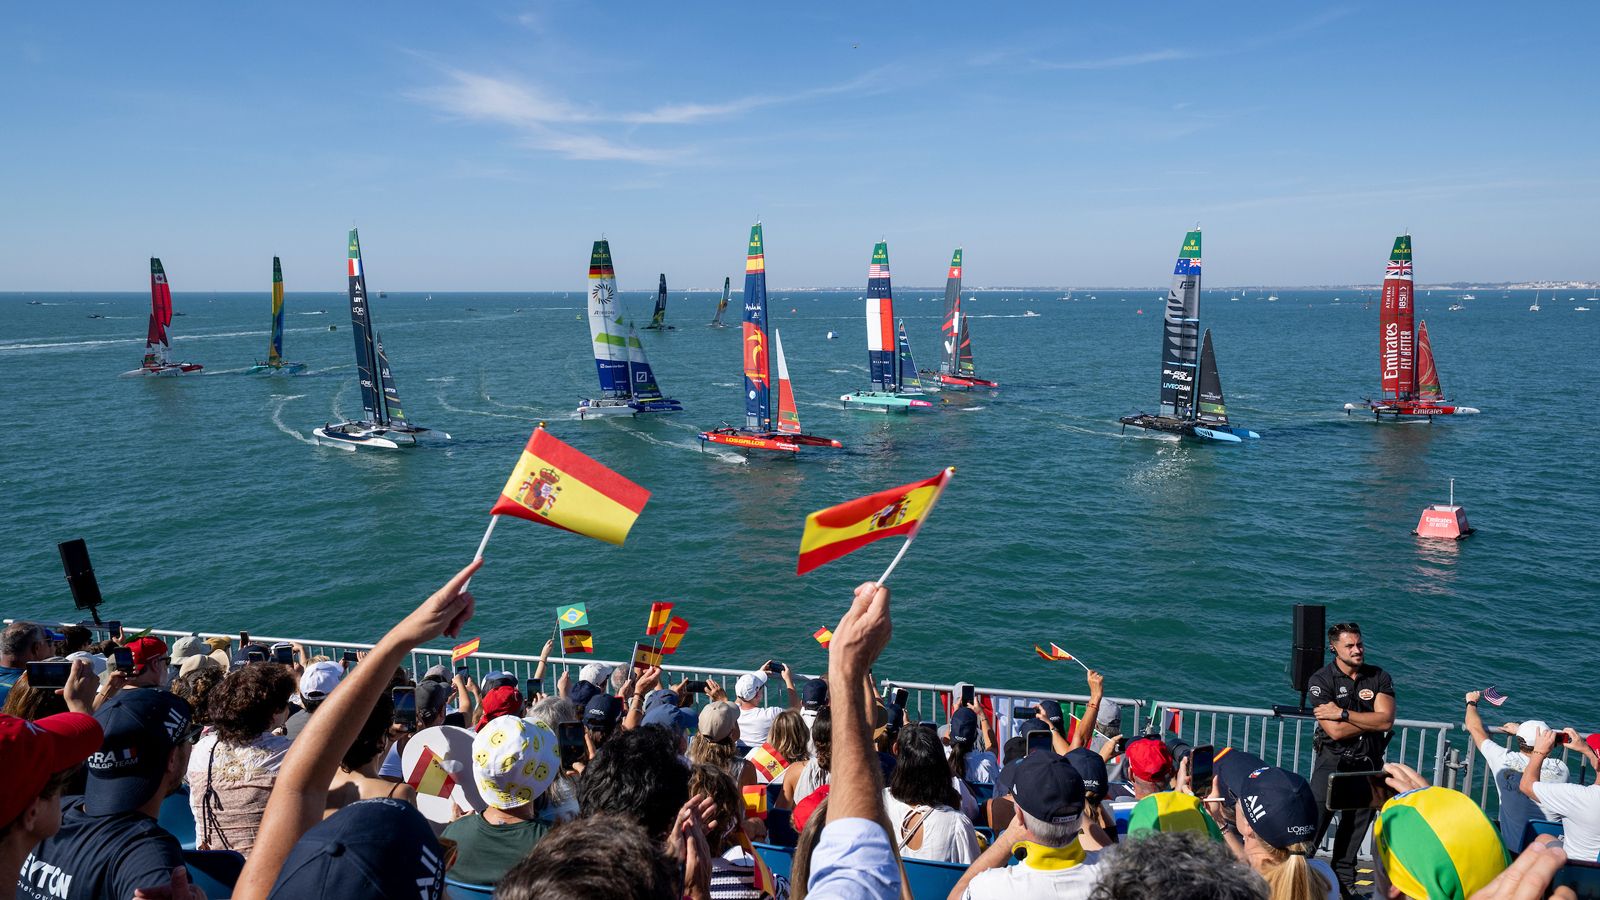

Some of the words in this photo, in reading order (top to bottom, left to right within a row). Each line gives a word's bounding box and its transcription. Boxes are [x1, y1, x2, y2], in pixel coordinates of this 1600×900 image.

[1383, 322, 1398, 380] Emirates
[1400, 330, 1411, 356] BETTER
[1400, 357, 1411, 370] FLY
[115, 757, 138, 768] TEAM
